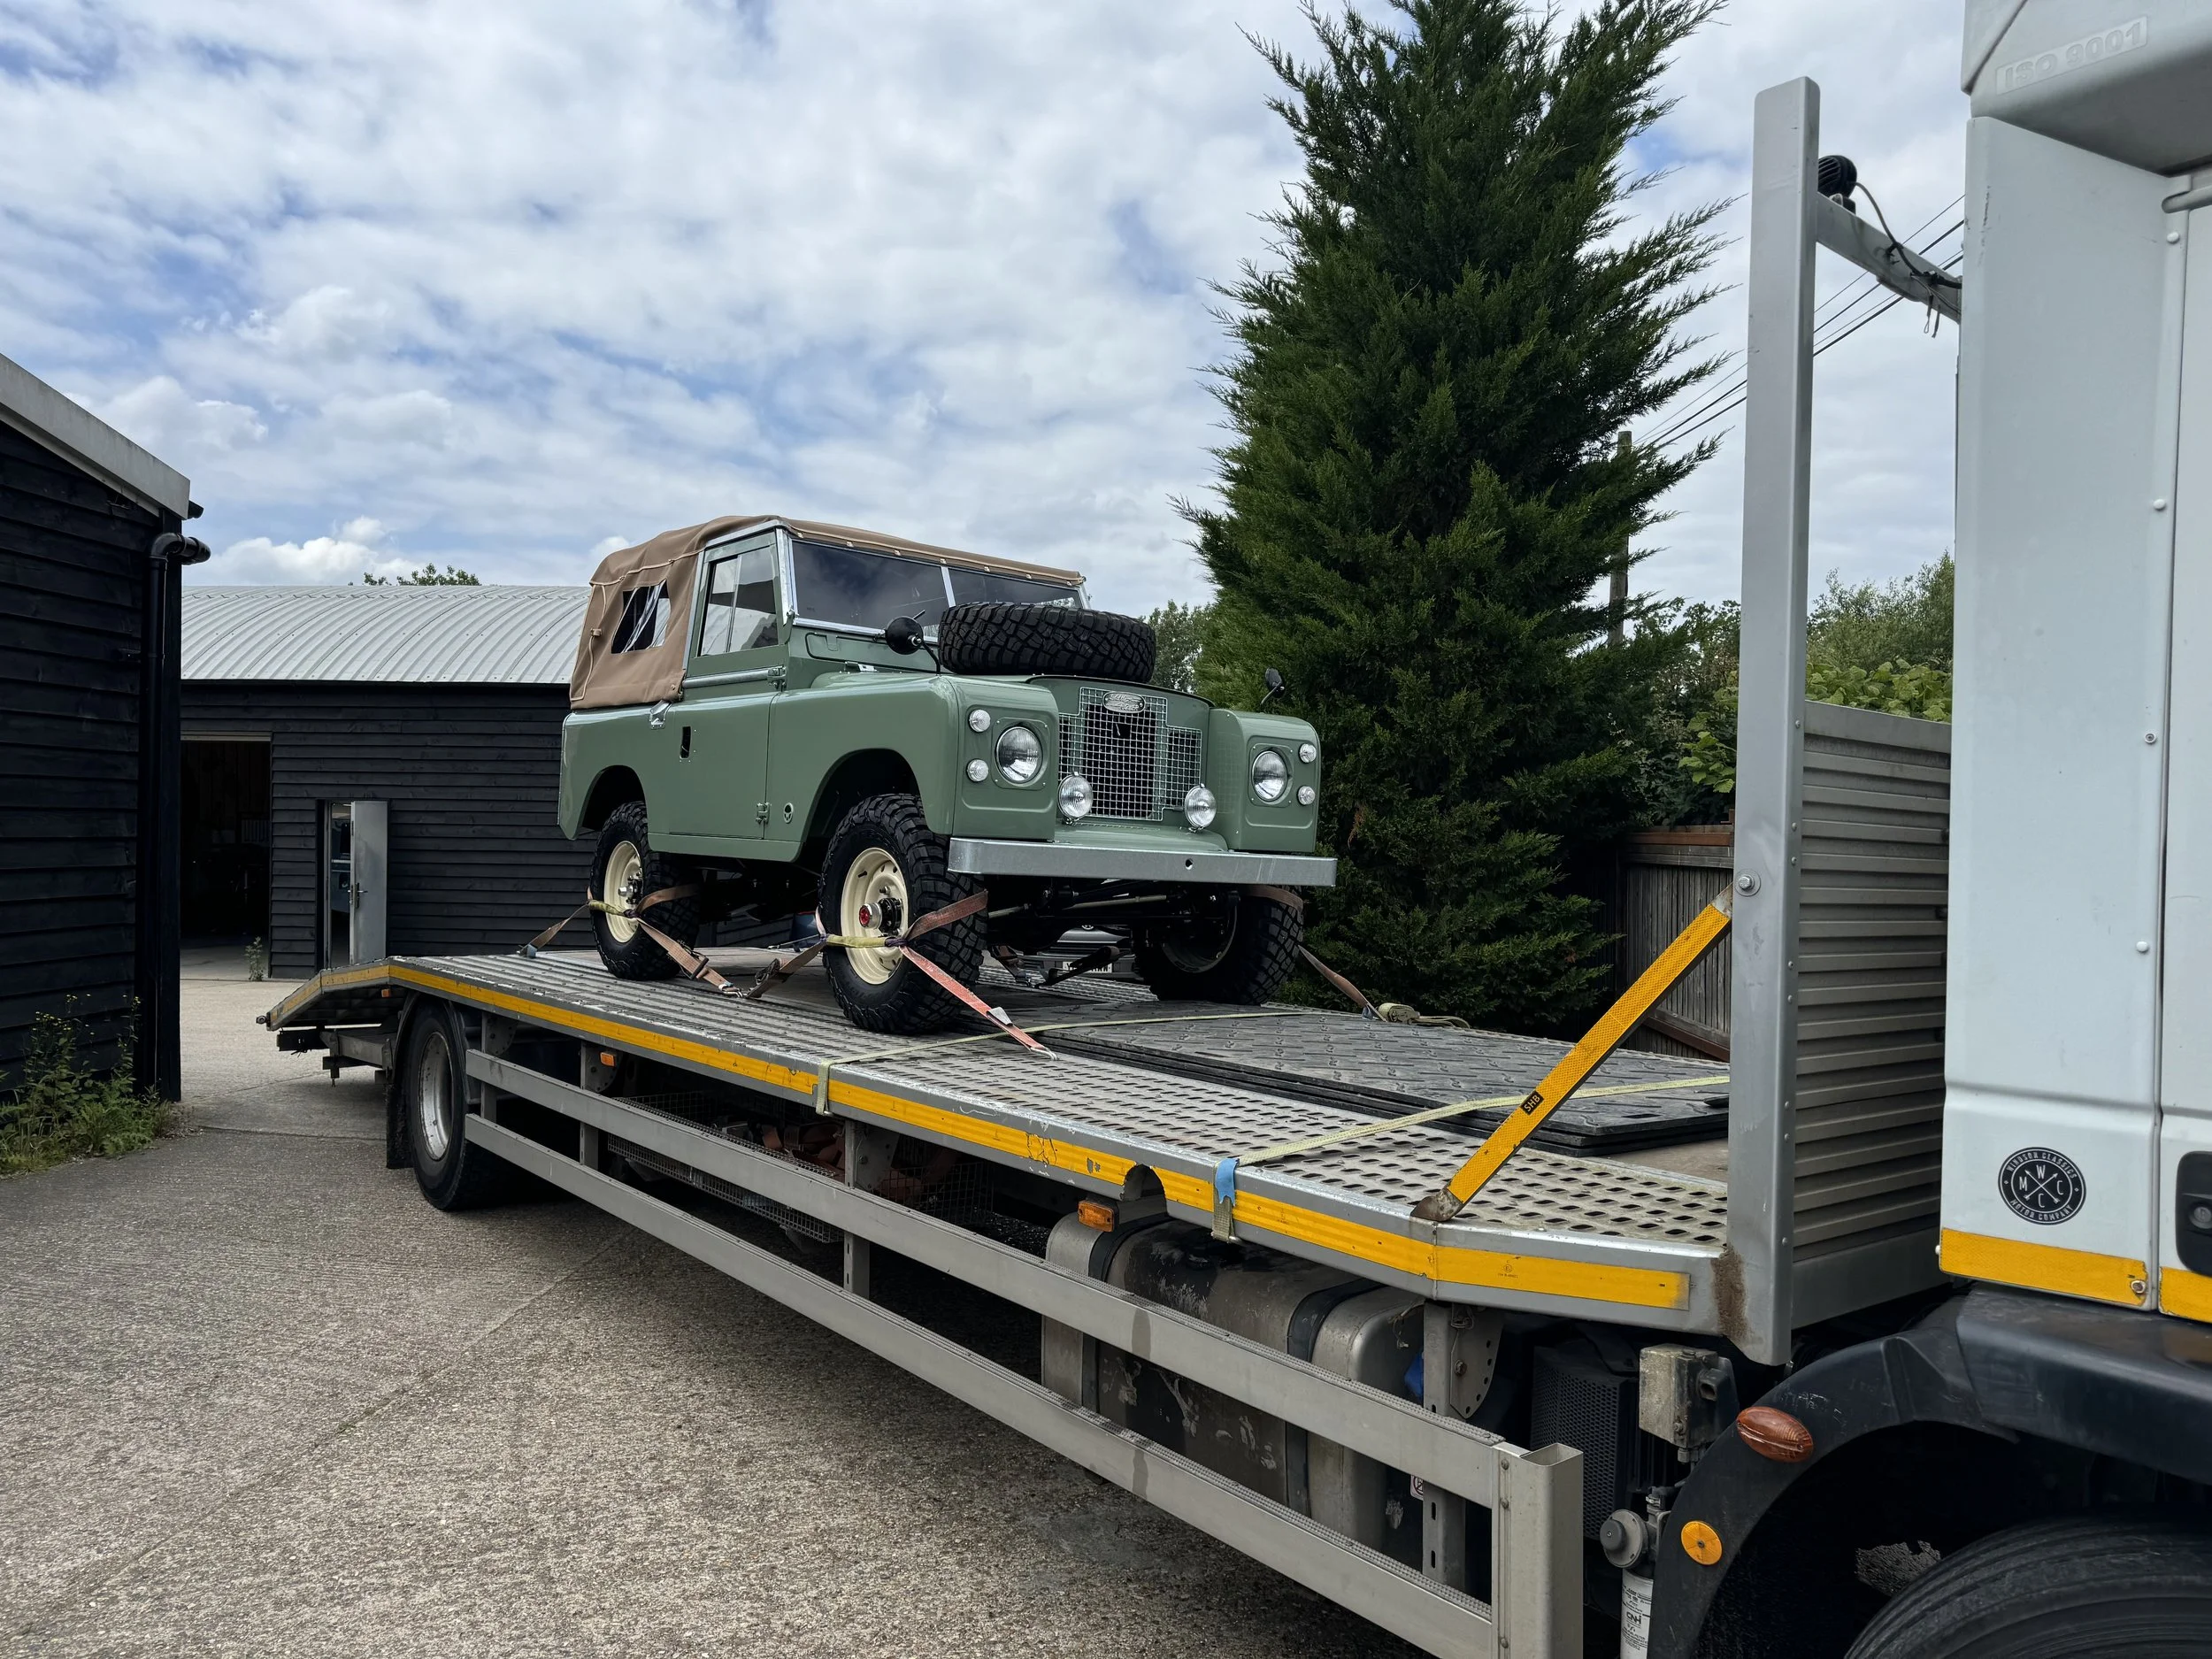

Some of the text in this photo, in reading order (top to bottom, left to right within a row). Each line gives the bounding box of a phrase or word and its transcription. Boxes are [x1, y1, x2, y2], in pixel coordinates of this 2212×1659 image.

[2005, 22, 2141, 88] ISO 9001
[1524, 1094, 1540, 1112] SHB
[2006, 1151, 2078, 1179] WINDSOR CLASSICS
[2009, 1199, 2073, 1221] MOTOR COMPANY
